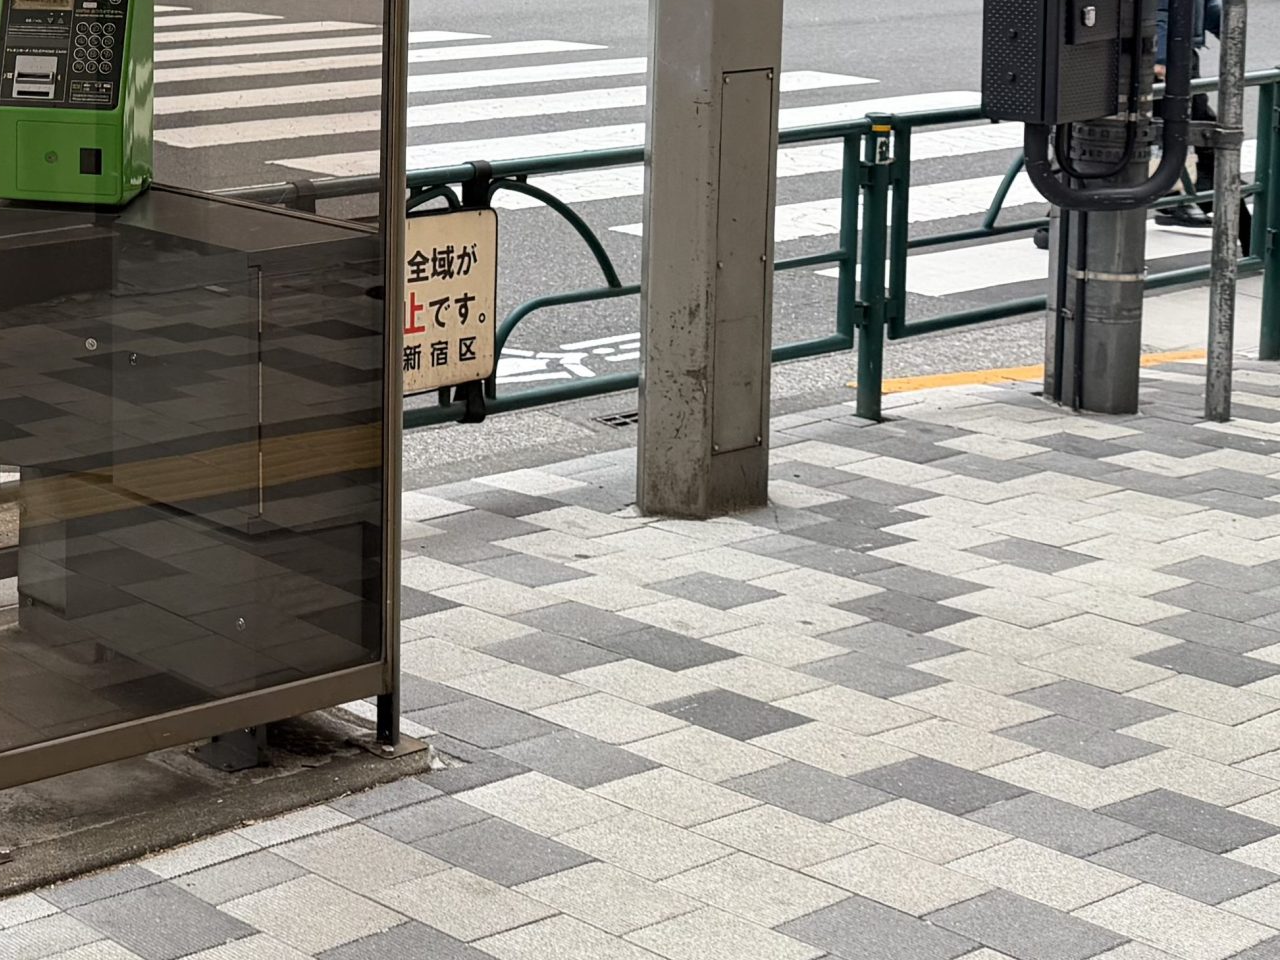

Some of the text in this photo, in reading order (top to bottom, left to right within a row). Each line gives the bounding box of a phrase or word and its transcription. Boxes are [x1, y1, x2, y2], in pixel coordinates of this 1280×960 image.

[406, 243, 478, 284] 全域が
[403, 292, 486, 335] 止です。
[403, 336, 477, 372] 新宿区
